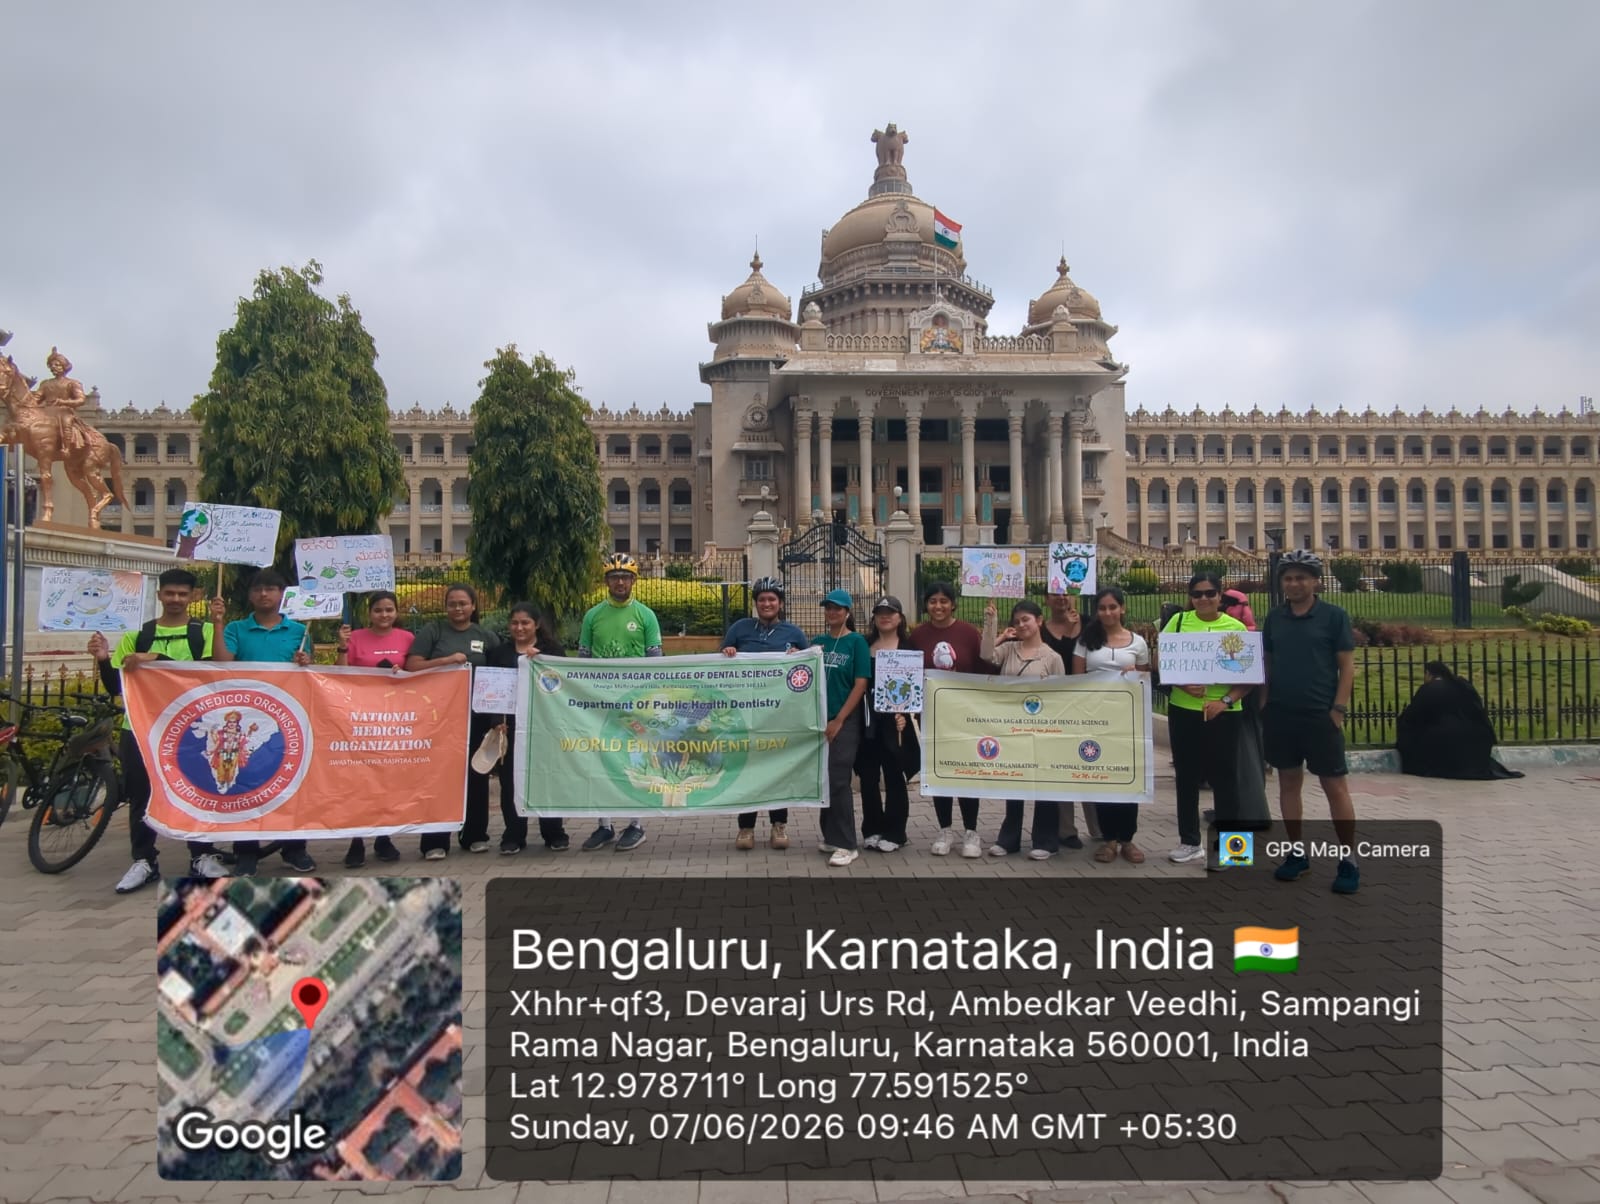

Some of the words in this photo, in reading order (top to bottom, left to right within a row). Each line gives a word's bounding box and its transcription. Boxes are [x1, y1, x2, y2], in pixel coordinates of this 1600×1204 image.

[864, 388, 925, 397] GOVERNMENT
[928, 388, 952, 397] WORK
[1181, 640, 1215, 653] POWER
[1179, 659, 1215, 672] PLANET
[567, 671, 620, 680] DAYANANDA
[622, 672, 651, 680] SAGAR
[655, 672, 692, 680] COLLEGE
[707, 670, 740, 679] DENTAL
[741, 669, 784, 678] SCIENCES
[568, 698, 634, 710] Department
[636, 700, 650, 709] Of
[653, 699, 689, 709] Public
[691, 699, 728, 710] Health
[730, 698, 782, 709] Dentistry
[350, 711, 418, 722] NATIONAL
[161, 710, 196, 756] NATIONAL
[195, 693, 251, 712] MEDICOS
[253, 695, 299, 756] ORGANISATION
[352, 725, 413, 737] MEDICOS
[329, 739, 432, 752] ORGANIZATION
[560, 737, 622, 753] WORLD
[627, 737, 751, 753] ENVIRONMENT
[755, 736, 789, 751] DAY
[648, 783, 684, 795] JUNE
